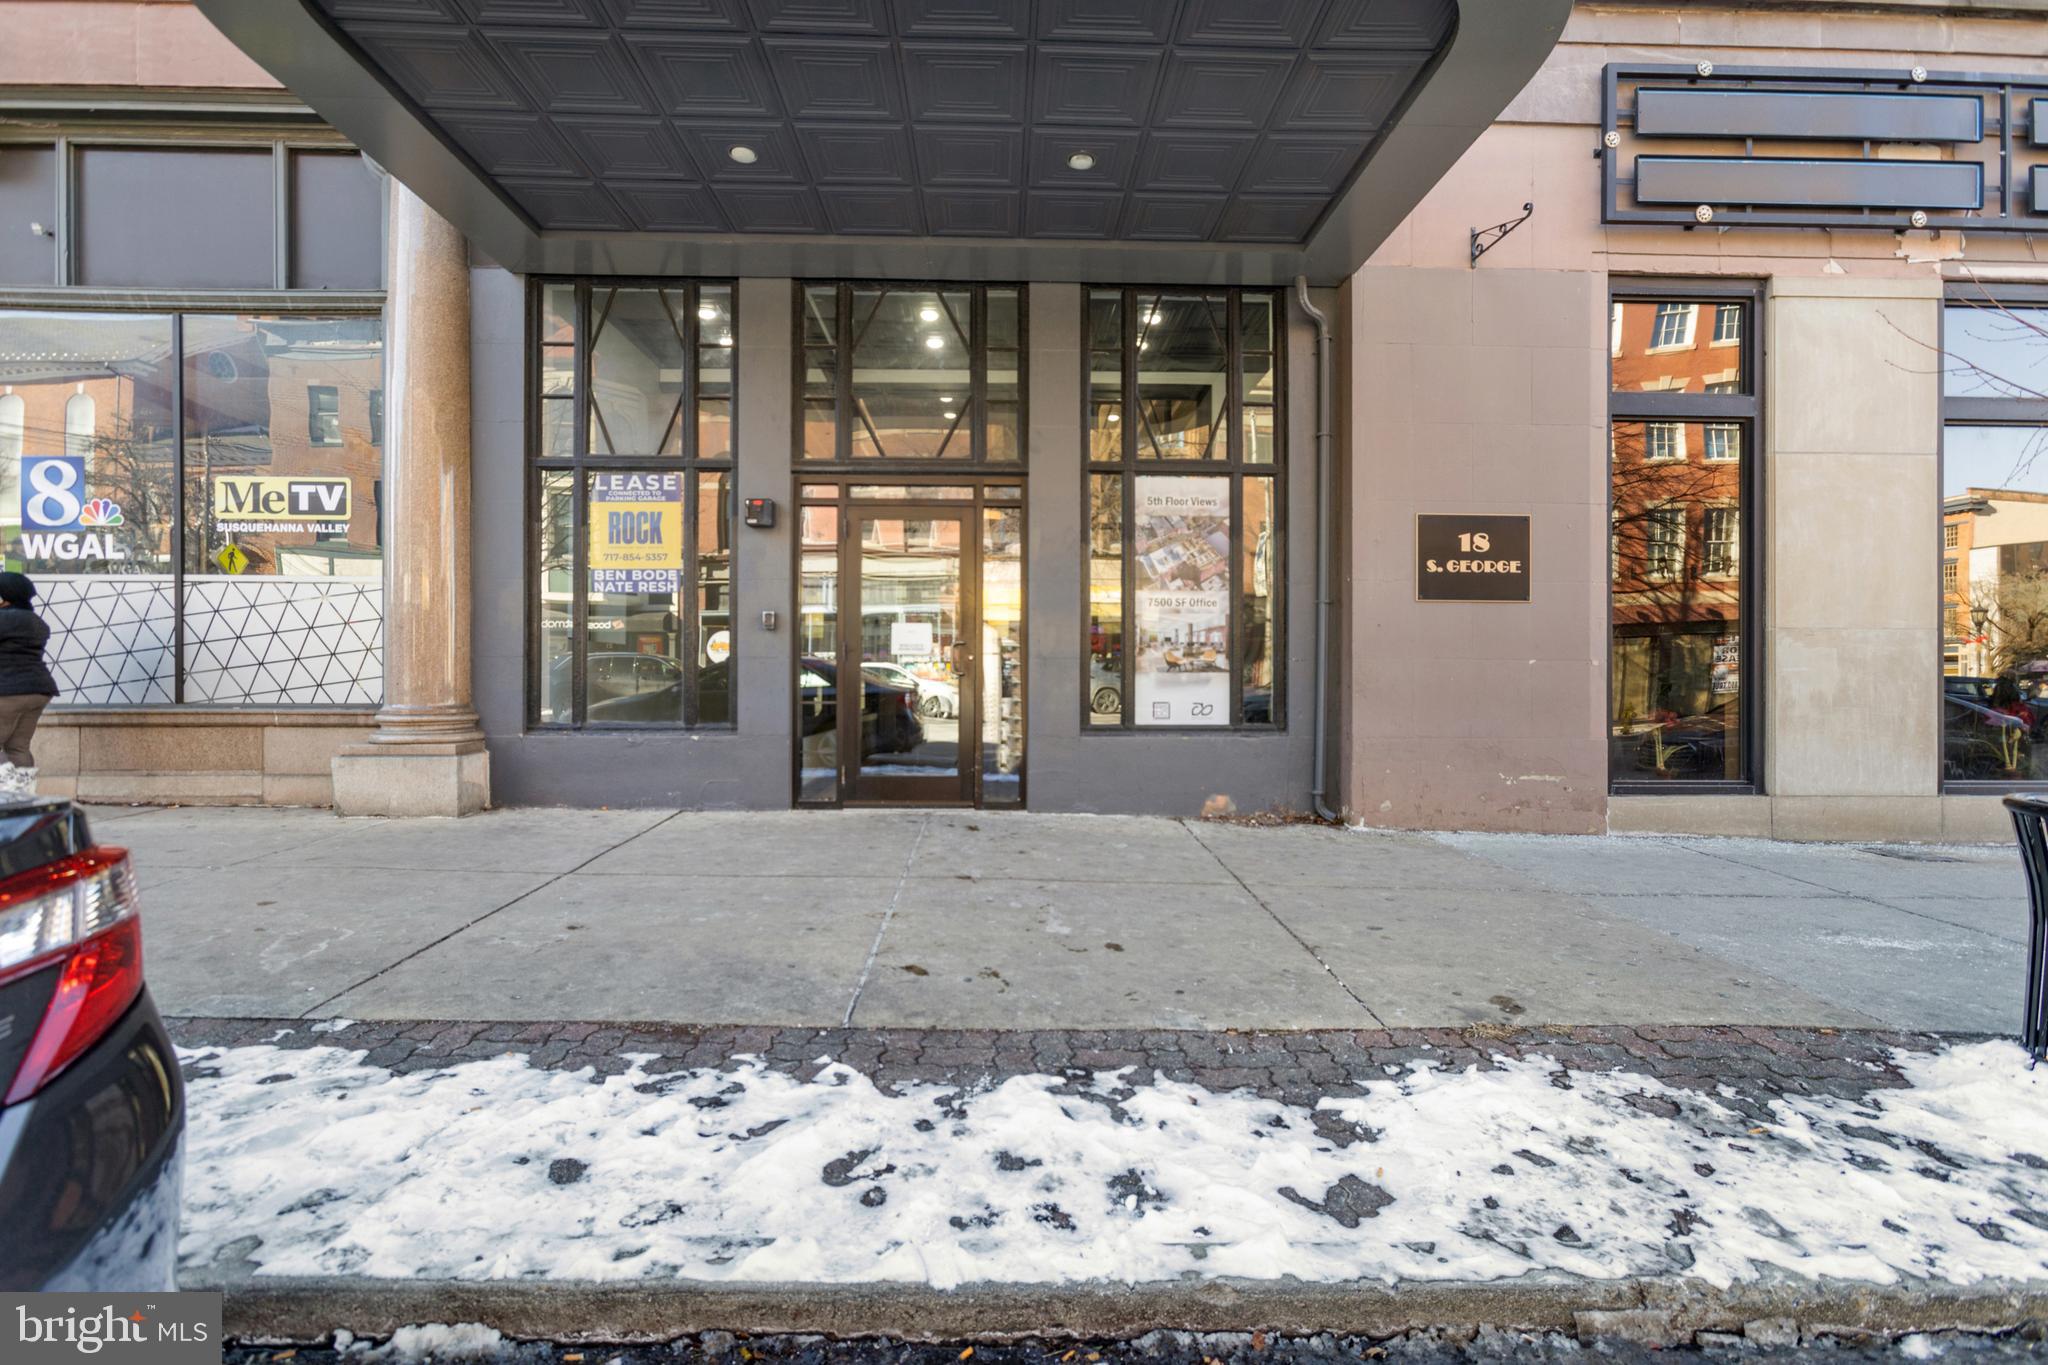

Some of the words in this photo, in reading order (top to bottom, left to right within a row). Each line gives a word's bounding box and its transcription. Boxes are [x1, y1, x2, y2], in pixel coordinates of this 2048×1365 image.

[595, 475, 677, 490] LEASE
[27, 459, 79, 527] 8
[220, 481, 345, 514] MeTV
[1147, 496, 1163, 506] 5th
[1165, 496, 1189, 506] Floor
[1190, 496, 1218, 506] Views
[216, 522, 304, 533] SUSQUEHANNA
[306, 522, 351, 533] VALLEY
[608, 511, 663, 545] ROCK
[21, 533, 125, 560] WGAL
[1458, 533, 1491, 552] 18
[603, 553, 669, 561] 717-854-5357
[1426, 560, 1443, 574] S.
[1446, 560, 1522, 574] GEORGE
[594, 570, 627, 581] BEN
[632, 570, 678, 581] BODE
[593, 581, 634, 593] NATE
[638, 581, 678, 593] RESH
[1148, 598, 1173, 608] 7500
[1175, 598, 1187, 608] SF
[1189, 597, 1218, 608] Office
